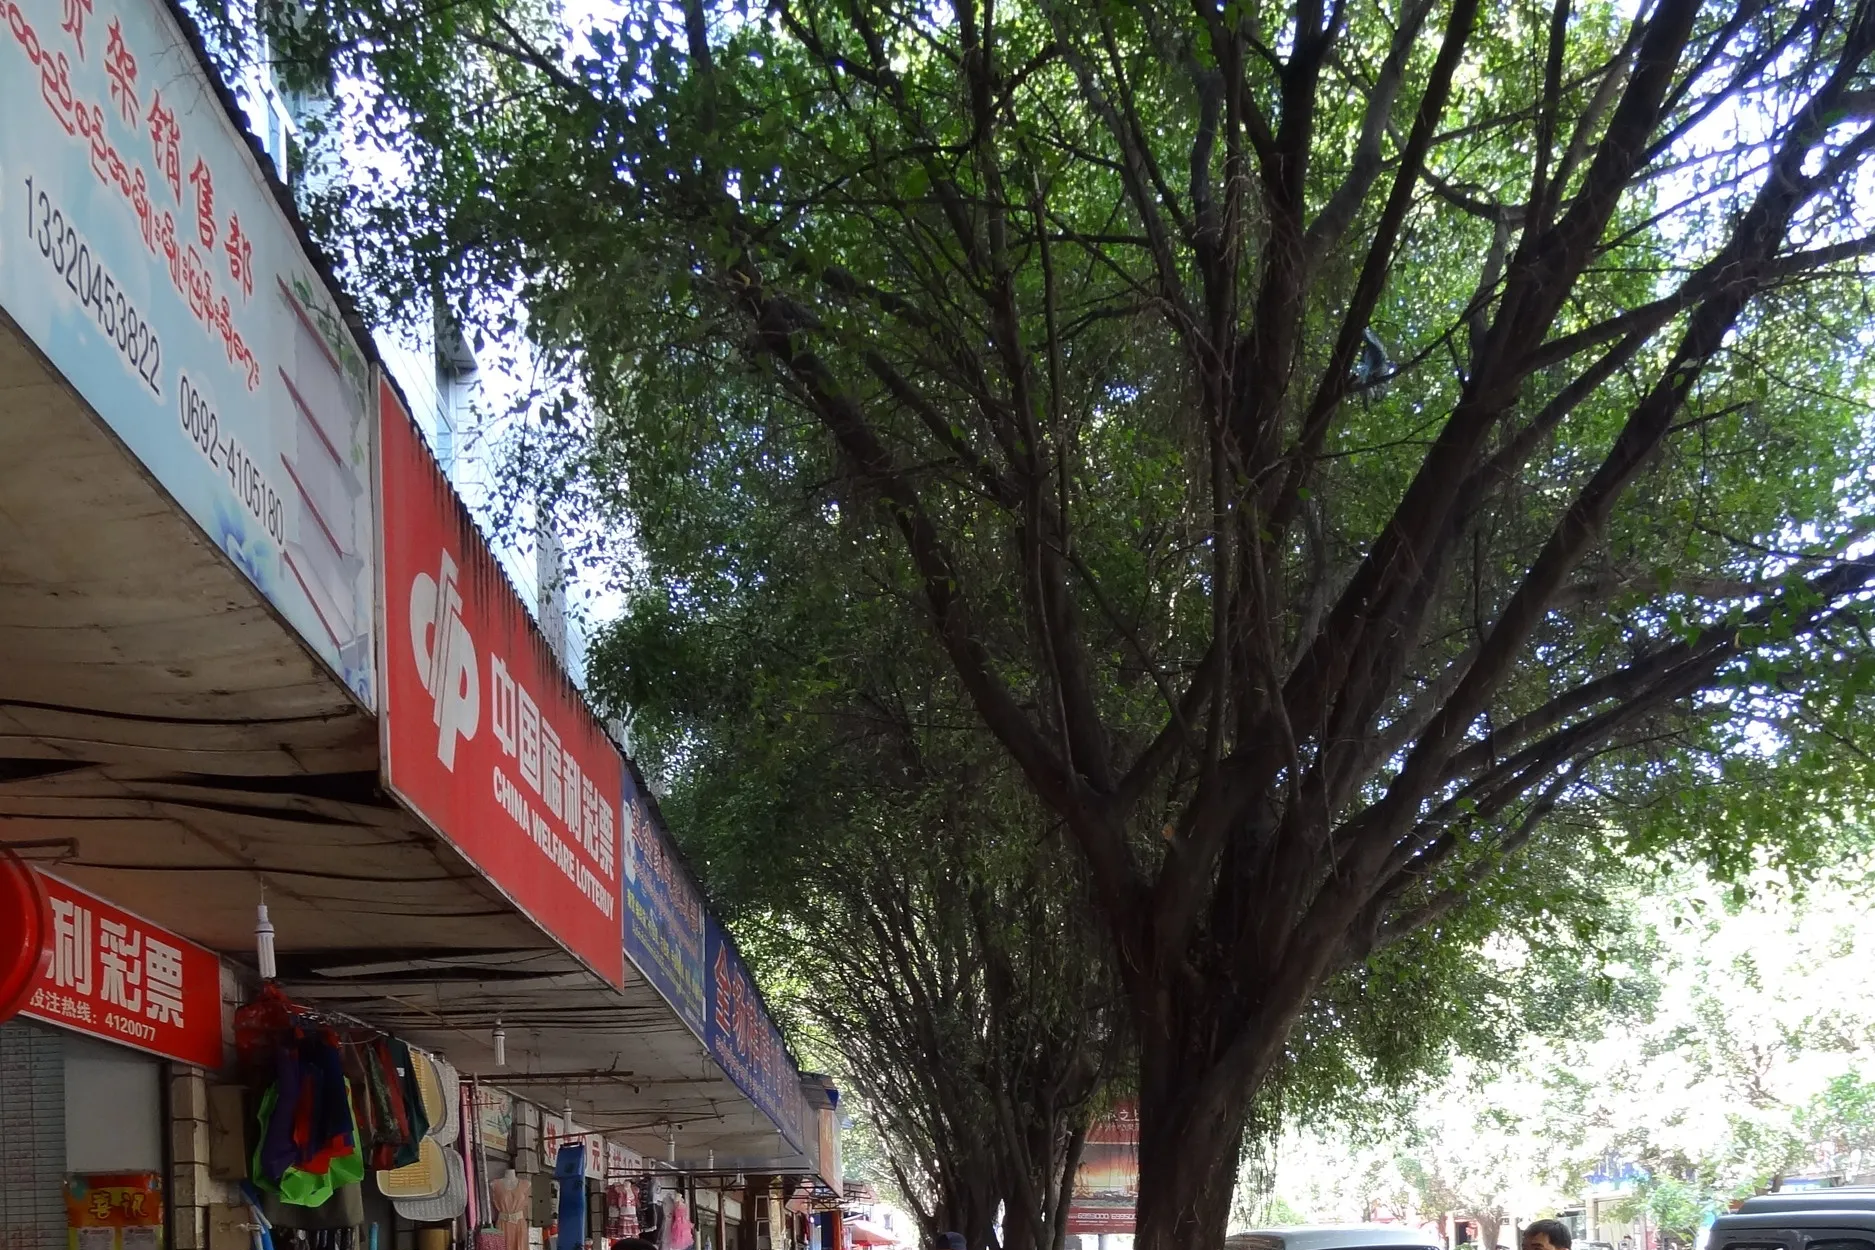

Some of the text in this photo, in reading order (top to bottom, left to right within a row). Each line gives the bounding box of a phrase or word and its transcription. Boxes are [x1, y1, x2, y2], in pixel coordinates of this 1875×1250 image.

[25, 175, 285, 547] 13320453822 0692-4105180
[491, 651, 614, 881] 中国福利彩票
[493, 766, 531, 836] CHINA
[531, 808, 575, 883] WELFARE
[45, 896, 184, 1028] 利彩票
[105, 1012, 156, 1042] 4120077
[89, 1190, 149, 1220] 喜讯
